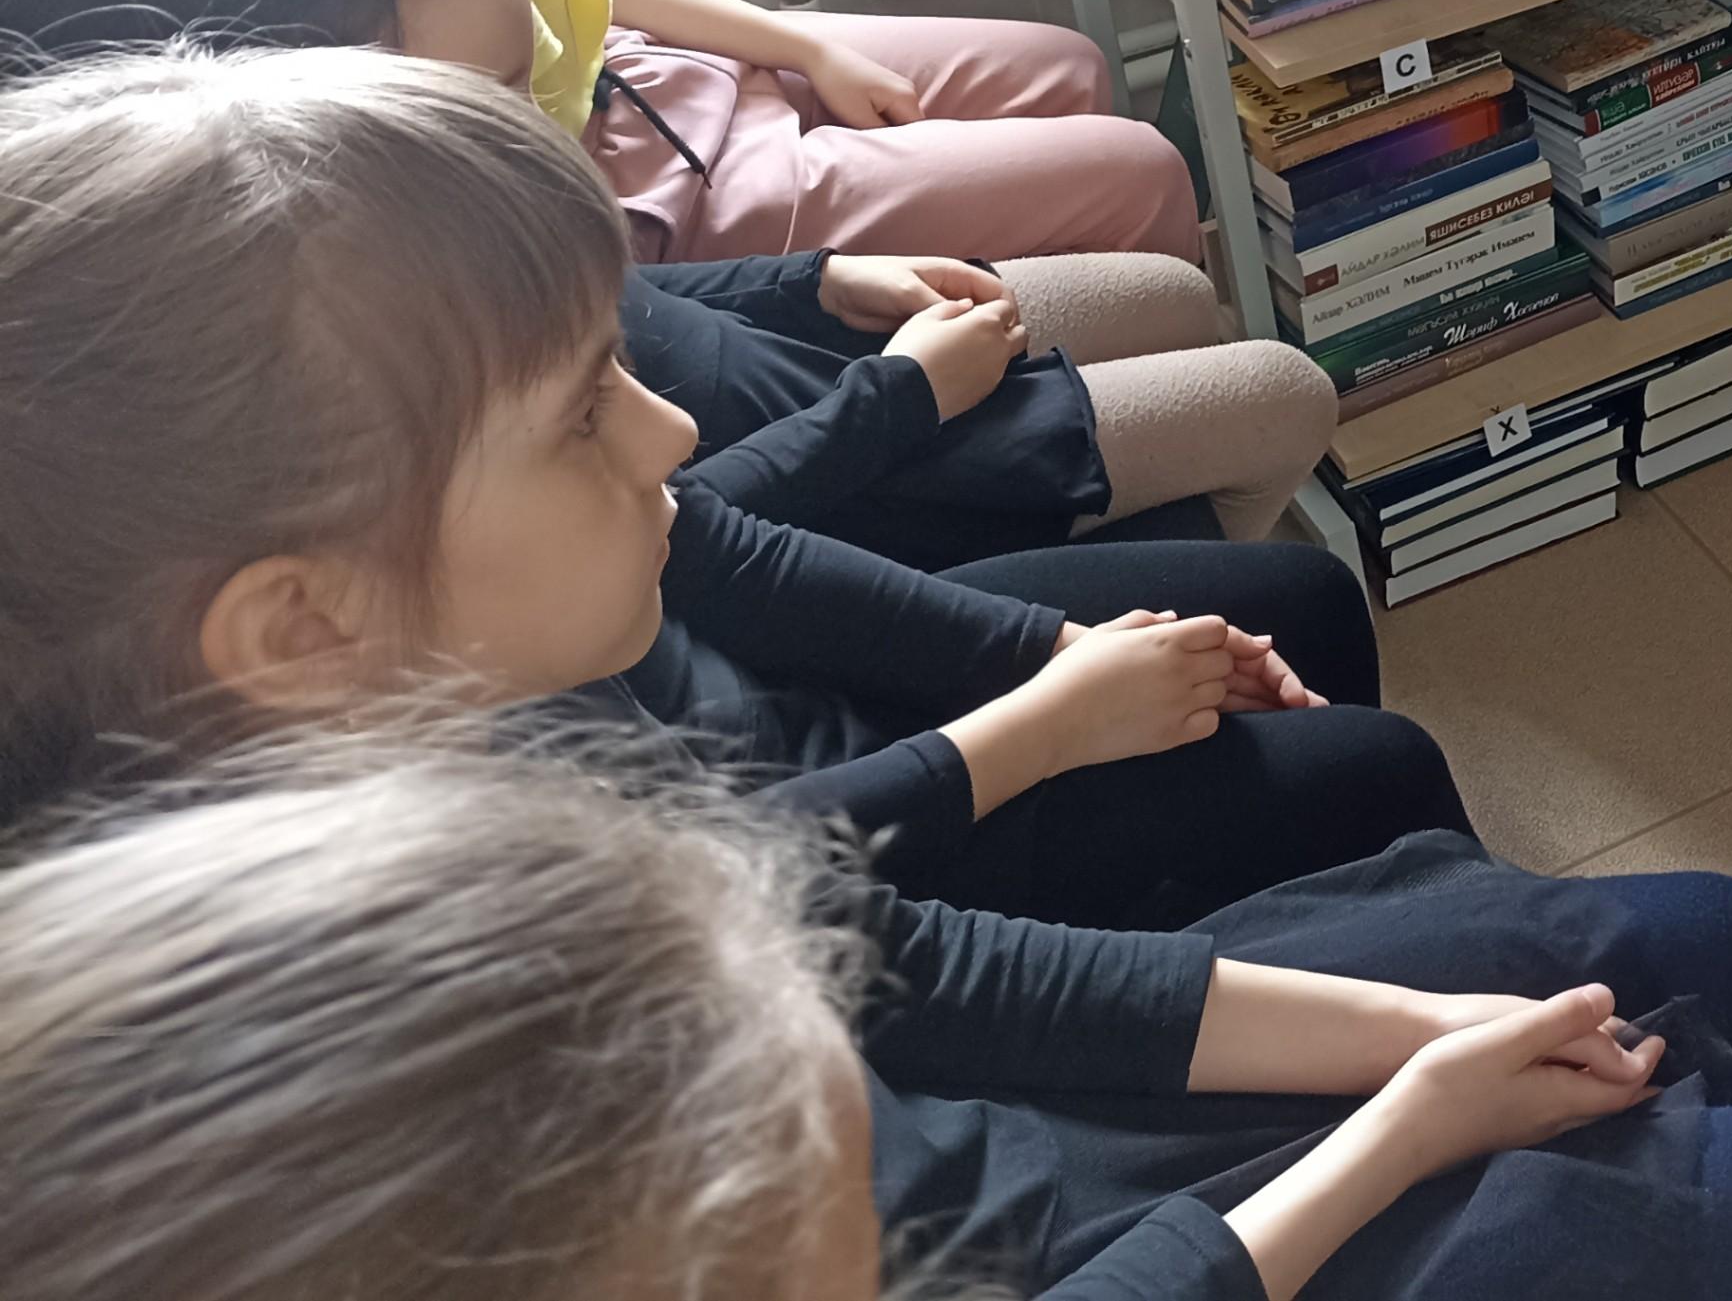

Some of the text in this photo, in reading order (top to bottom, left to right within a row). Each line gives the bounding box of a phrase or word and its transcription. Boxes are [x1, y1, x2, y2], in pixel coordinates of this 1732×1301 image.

[1395, 54, 1417, 77] С
[1429, 204, 1494, 241] ЯШИСЕБЕЗ
[1497, 415, 1518, 441] Х
